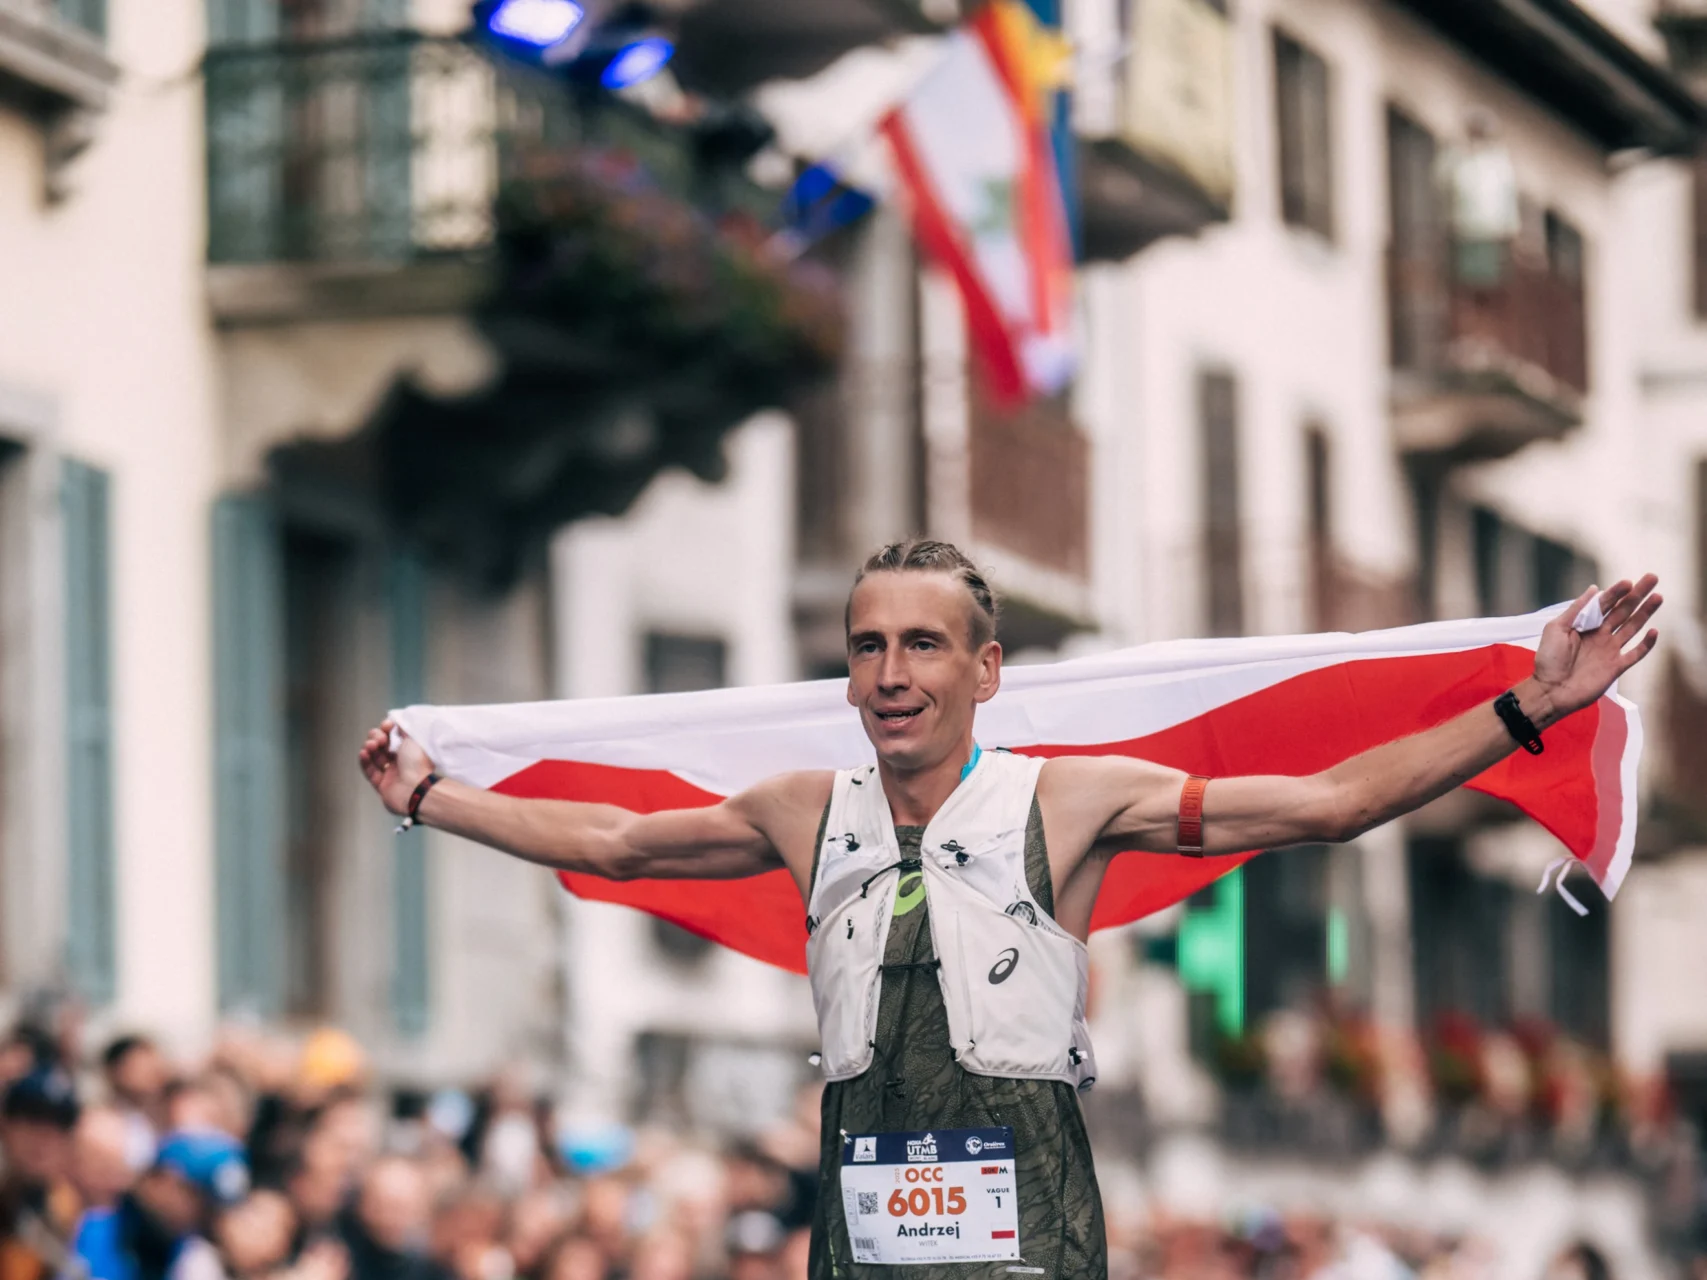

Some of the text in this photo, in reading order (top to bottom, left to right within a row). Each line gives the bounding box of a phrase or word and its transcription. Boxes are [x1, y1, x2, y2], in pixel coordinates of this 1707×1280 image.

[907, 1144, 938, 1156] UTMB
[904, 1167, 944, 1183] OCC
[998, 1166, 1008, 1174] M
[887, 1186, 967, 1217] 6015
[995, 1196, 1001, 1209] 1
[896, 1221, 961, 1239] Andrzej
[919, 1239, 938, 1247] WITEK
